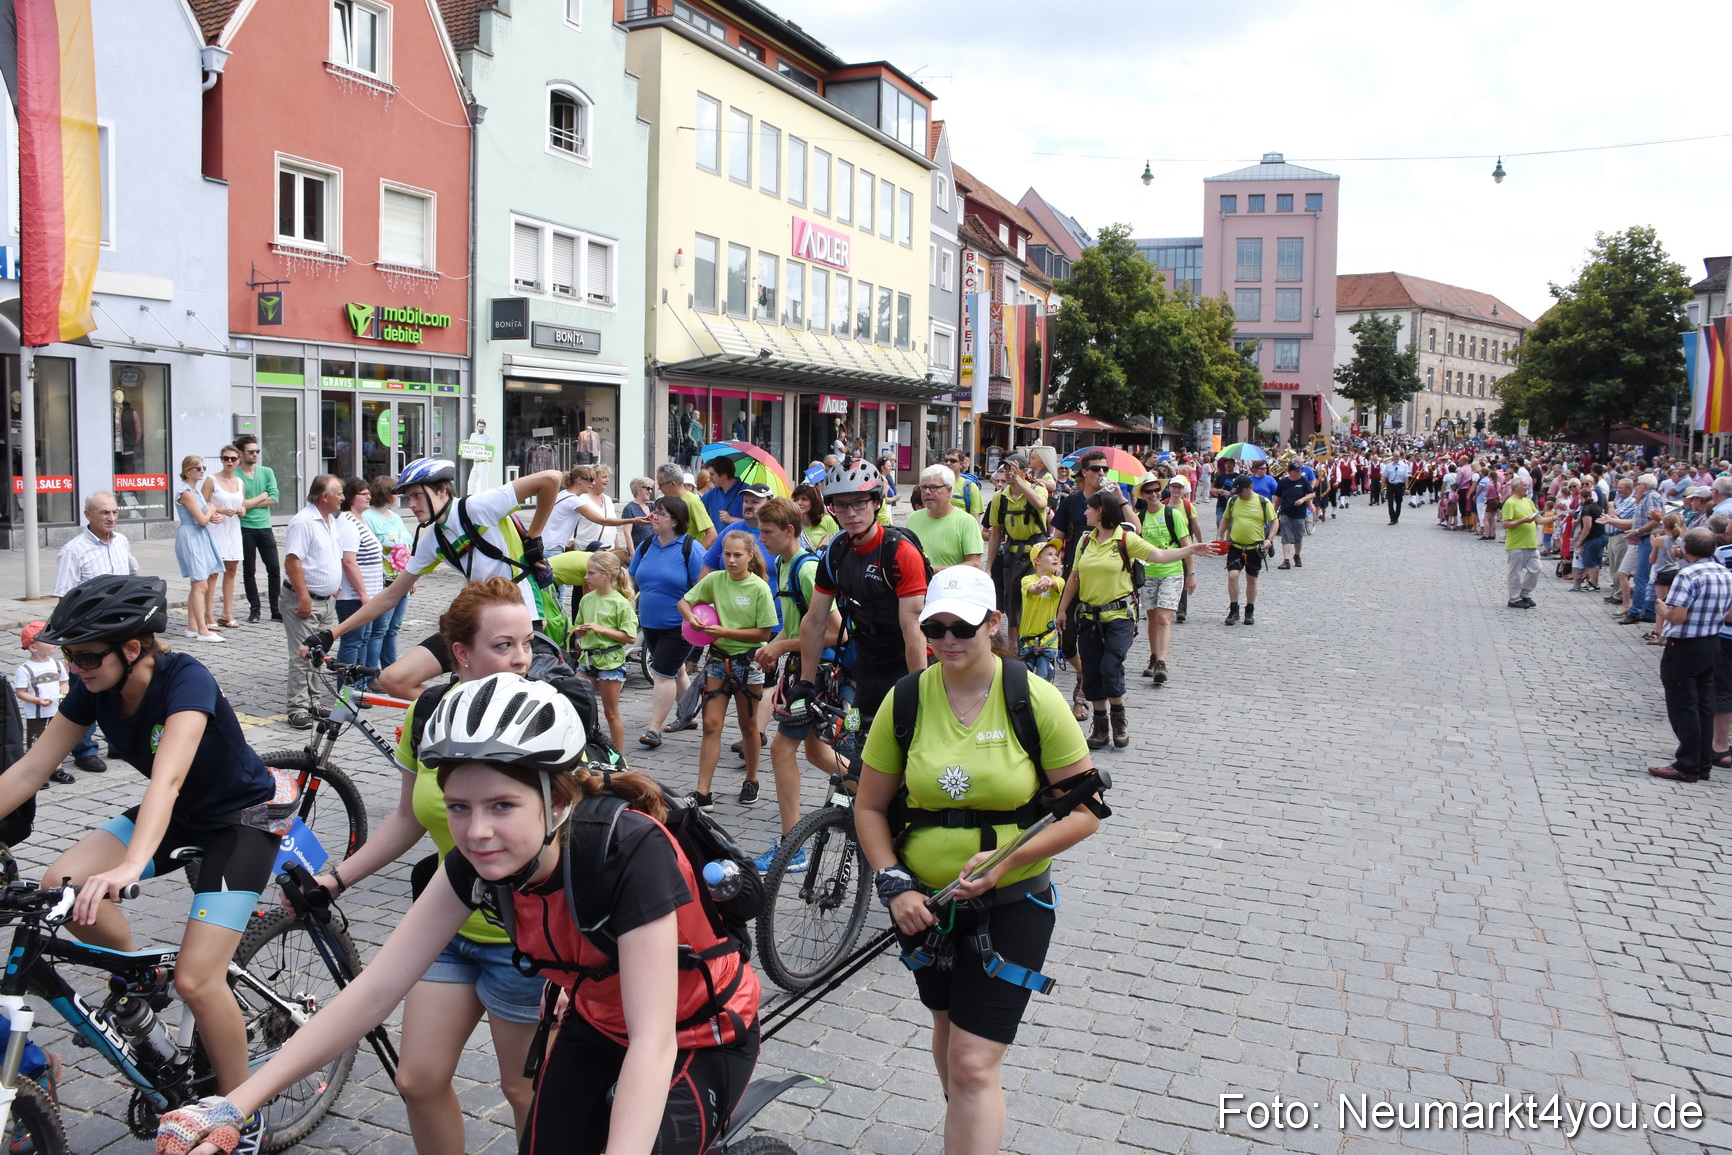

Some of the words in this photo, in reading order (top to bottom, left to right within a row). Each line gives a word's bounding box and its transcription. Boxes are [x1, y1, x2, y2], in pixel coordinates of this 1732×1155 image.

[798, 220, 850, 268] ADLER
[384, 306, 452, 328] mobilcom
[494, 318, 523, 330] BONITA
[383, 324, 425, 344] debitel
[556, 330, 585, 346] BONITA
[322, 377, 352, 388] GRAVIS
[1261, 380, 1300, 390] arkasse
[822, 395, 848, 414] ADLER
[16, 480, 41, 490] FIL
[40, 479, 61, 489] SALE
[116, 478, 137, 487] FINAL
[137, 478, 156, 487] SALE
[985, 729, 1006, 740] DAV
